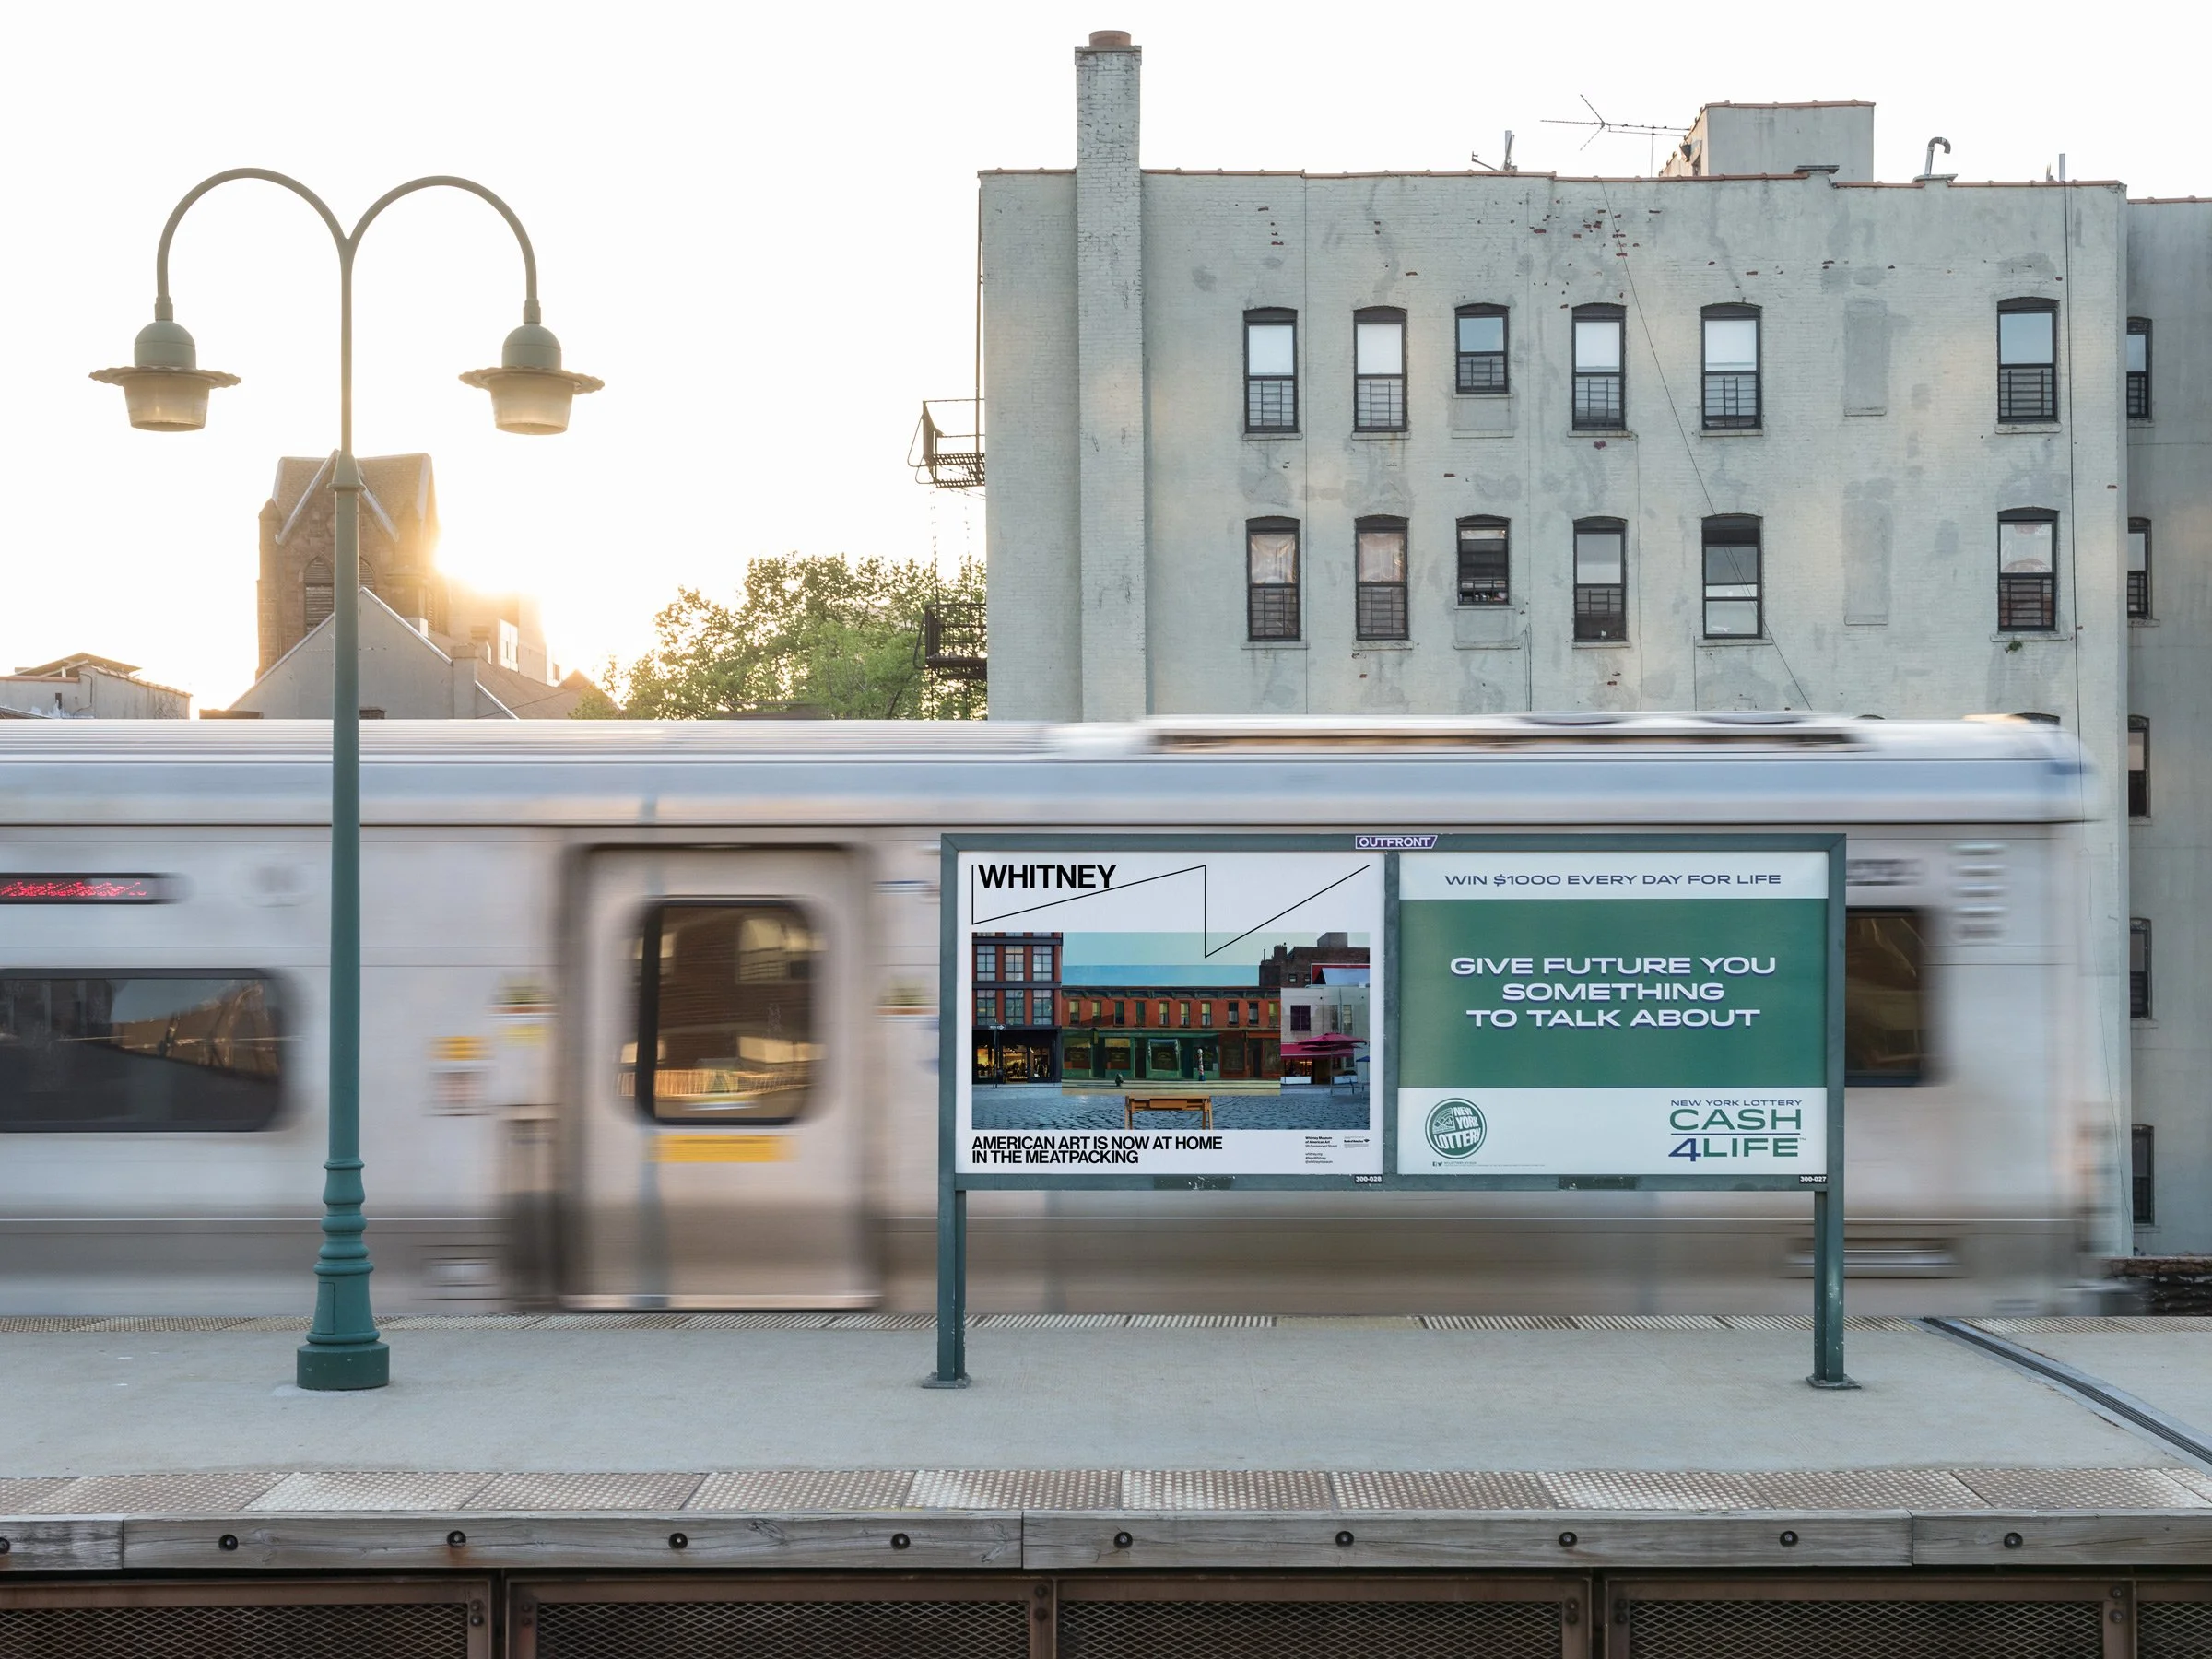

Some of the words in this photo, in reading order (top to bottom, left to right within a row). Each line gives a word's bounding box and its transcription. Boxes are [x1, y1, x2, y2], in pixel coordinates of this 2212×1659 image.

[1359, 837, 1431, 847] OUTFRONT
[977, 864, 1117, 889] WHITNEY
[1445, 875, 1488, 885] WIN
[1493, 874, 1560, 887] $1000
[1567, 875, 1637, 885] EVERY
[1642, 875, 1683, 885] DAY
[1688, 875, 1731, 885] FOR
[1737, 875, 1782, 885] LIFE
[1450, 957, 1534, 975] GIVE
[1543, 957, 1691, 975] FUTURE
[1700, 957, 1776, 975] YOU
[1502, 982, 1724, 1002] SOMETHING
[1465, 1009, 1518, 1028] TO
[1526, 1009, 1621, 1028] TALK
[1630, 1009, 1760, 1028] ABOUT
[1453, 1106, 1474, 1117] NEW
[1455, 1115, 1479, 1130] YORK
[1669, 1109, 1801, 1131] CASH
[971, 1136, 1055, 1150] AMERICAN
[1059, 1136, 1090, 1150] ART
[1093, 1136, 1107, 1150] IS
[1111, 1136, 1149, 1150] NOW
[1152, 1136, 1172, 1150] AT
[1175, 1136, 1223, 1150] HOME
[1433, 1127, 1482, 1149] LOTTERY
[971, 1150, 987, 1164] IN
[990, 1150, 1022, 1164] THE
[1025, 1150, 1139, 1164] MEATPACKING
